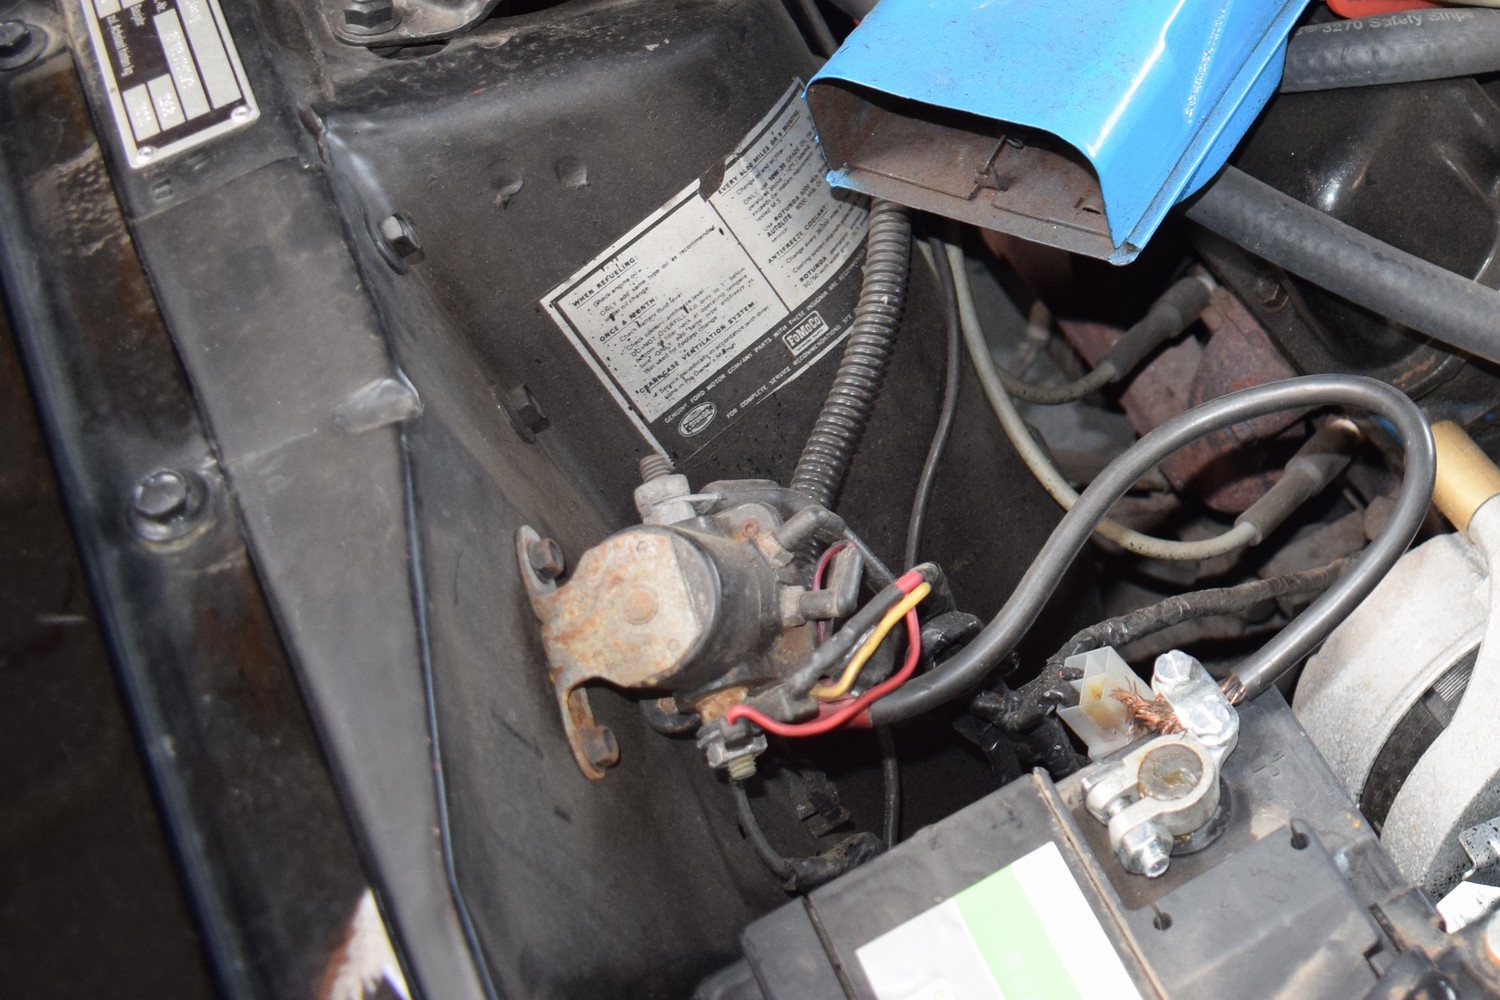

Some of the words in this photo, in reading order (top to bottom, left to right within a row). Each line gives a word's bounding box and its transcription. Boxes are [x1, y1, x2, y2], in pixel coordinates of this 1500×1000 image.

[1323, 19, 1363, 34] 3270
[1368, 12, 1423, 30] Safety
[1429, 8, 1475, 23] Stripe
[717, 173, 737, 196] EVERY
[752, 144, 769, 164] MILES
[736, 174, 755, 197] Change
[773, 194, 799, 222] ROTUNDA
[766, 211, 791, 239] AUTOLITE
[767, 227, 803, 266] ANTIFREEZE
[785, 243, 804, 265] Change
[799, 253, 827, 284] ROTUNDA
[571, 288, 594, 307] WHEN
[599, 300, 617, 316] ONLY
[618, 290, 630, 301] add
[631, 279, 646, 292] same
[647, 268, 660, 280] type
[610, 277, 630, 294] engine
[628, 286, 649, 304] change
[642, 335, 656, 348] NOT
[728, 266, 745, 281] below
[598, 325, 619, 342] ONCE
[618, 326, 637, 342] Check
[697, 315, 717, 333] change
[785, 316, 822, 347] FoMoCo
[625, 335, 643, 351] Check
[681, 323, 725, 360] VENTILATION
[689, 387, 707, 403] FORD
[706, 373, 726, 391] MOTOR
[754, 336, 772, 353] PARTS
[773, 325, 788, 338] WITH
[788, 310, 806, 325] THESE
[828, 281, 839, 291] ARE
[726, 407, 738, 419] FOR
[740, 384, 768, 408] COMPLETE
[769, 365, 791, 385] SERVICE
